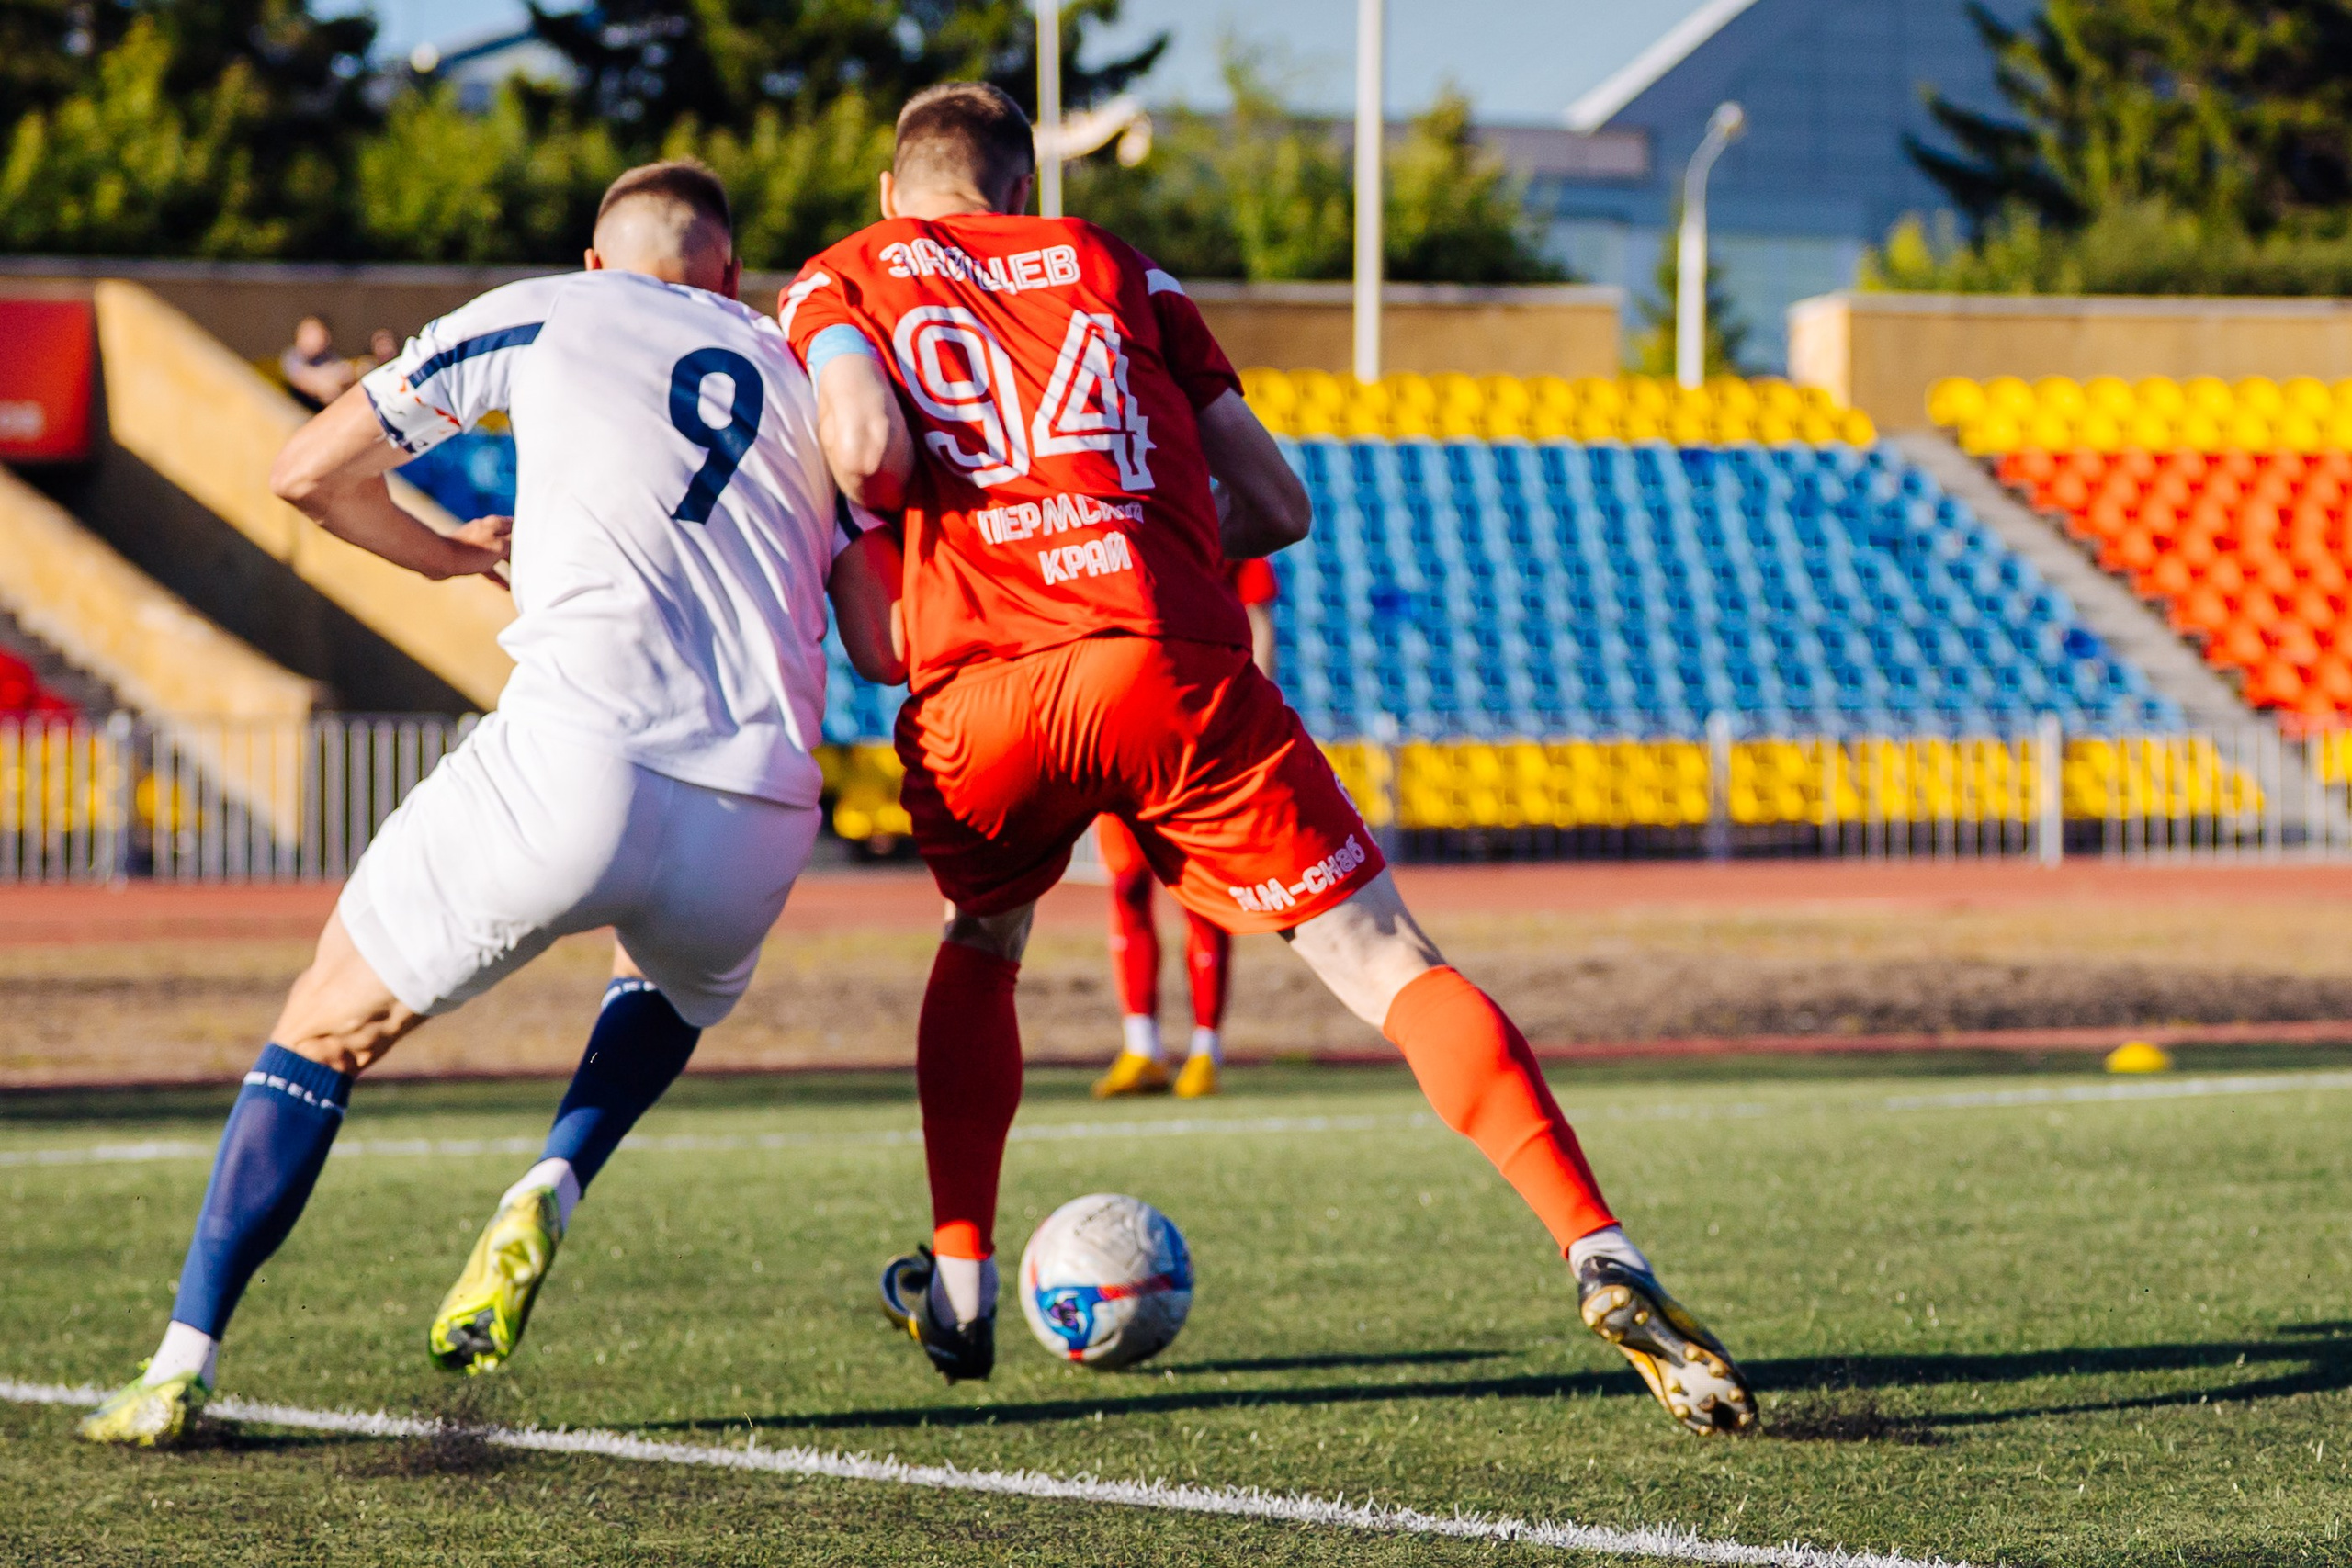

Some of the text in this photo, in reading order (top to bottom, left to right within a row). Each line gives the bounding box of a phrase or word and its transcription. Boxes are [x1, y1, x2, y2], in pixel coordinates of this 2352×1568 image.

[669, 347, 764, 525] 9
[892, 305, 1158, 491] 94
[1038, 530, 1134, 586] КРАЙ
